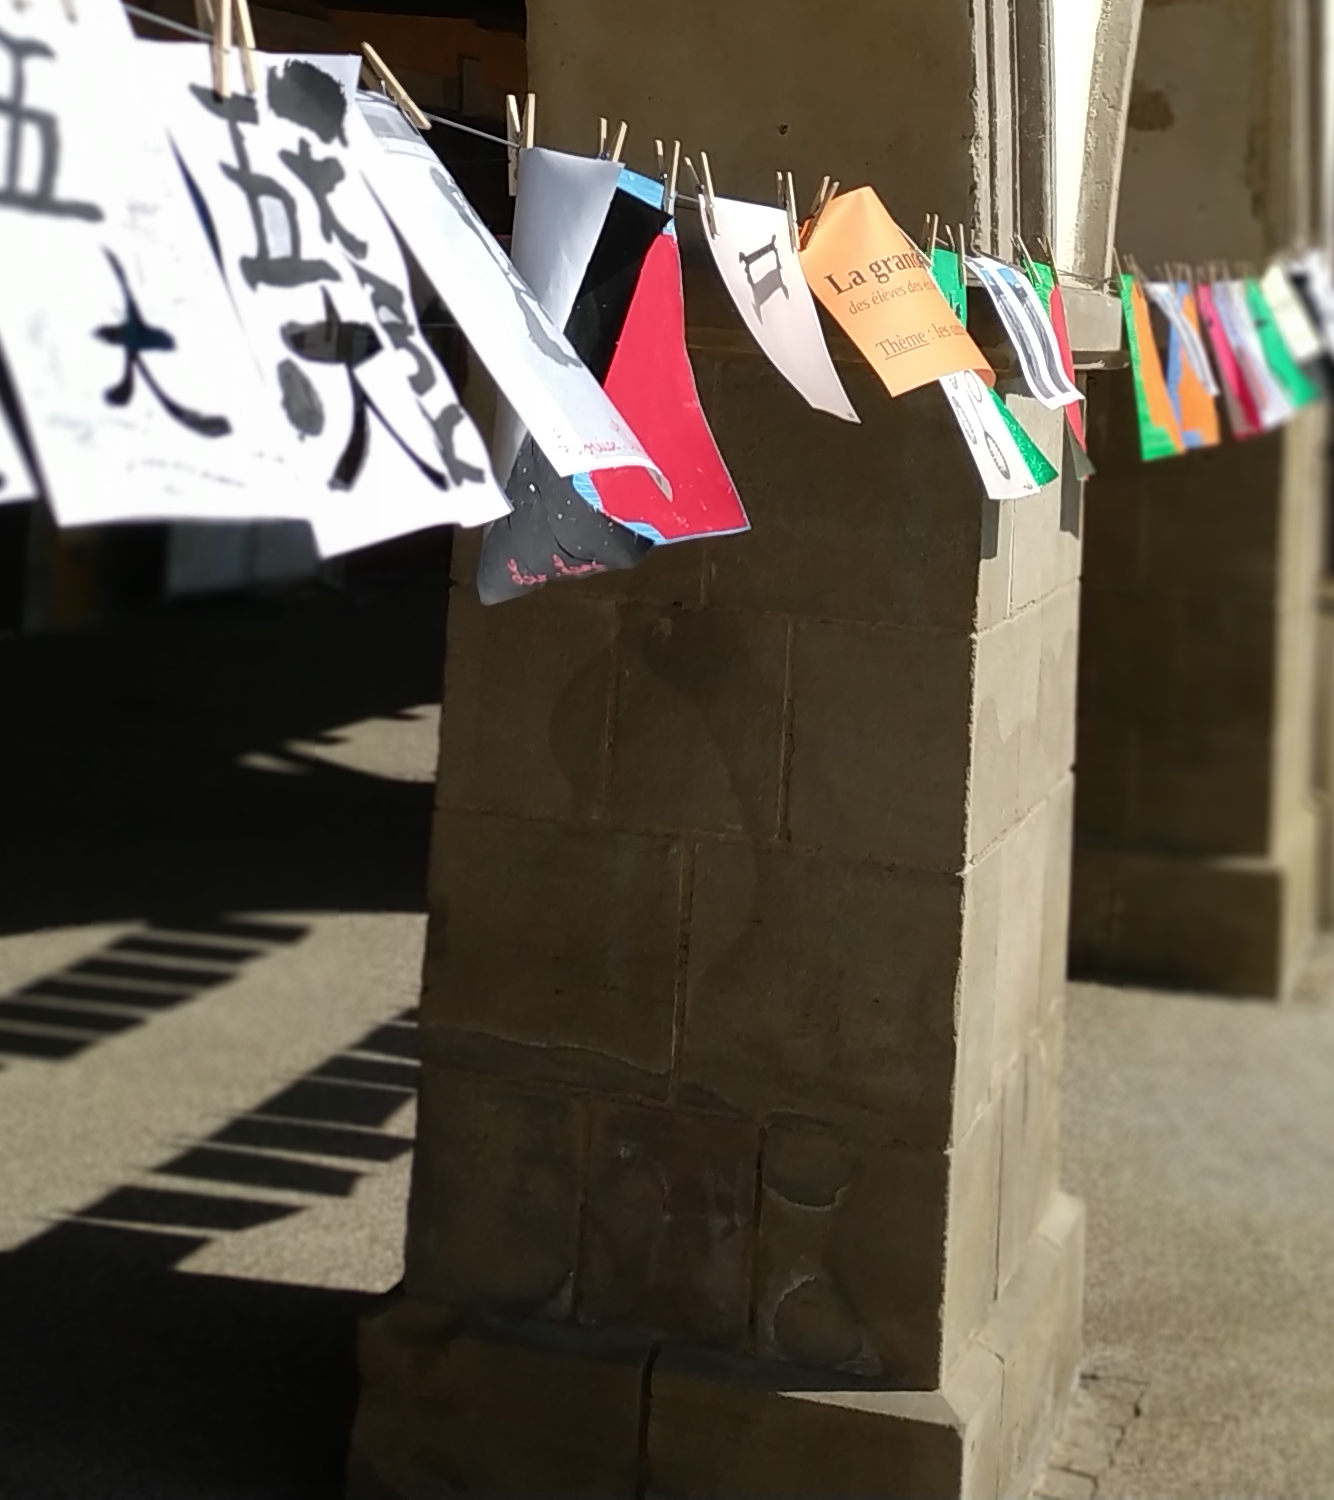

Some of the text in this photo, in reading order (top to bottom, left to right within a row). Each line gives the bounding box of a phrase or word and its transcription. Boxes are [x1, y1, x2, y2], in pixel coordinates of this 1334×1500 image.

[823, 247, 924, 296] La grand
[848, 299, 870, 315] des
[875, 332, 928, 357] Thème
[931, 322, 952, 339] les
